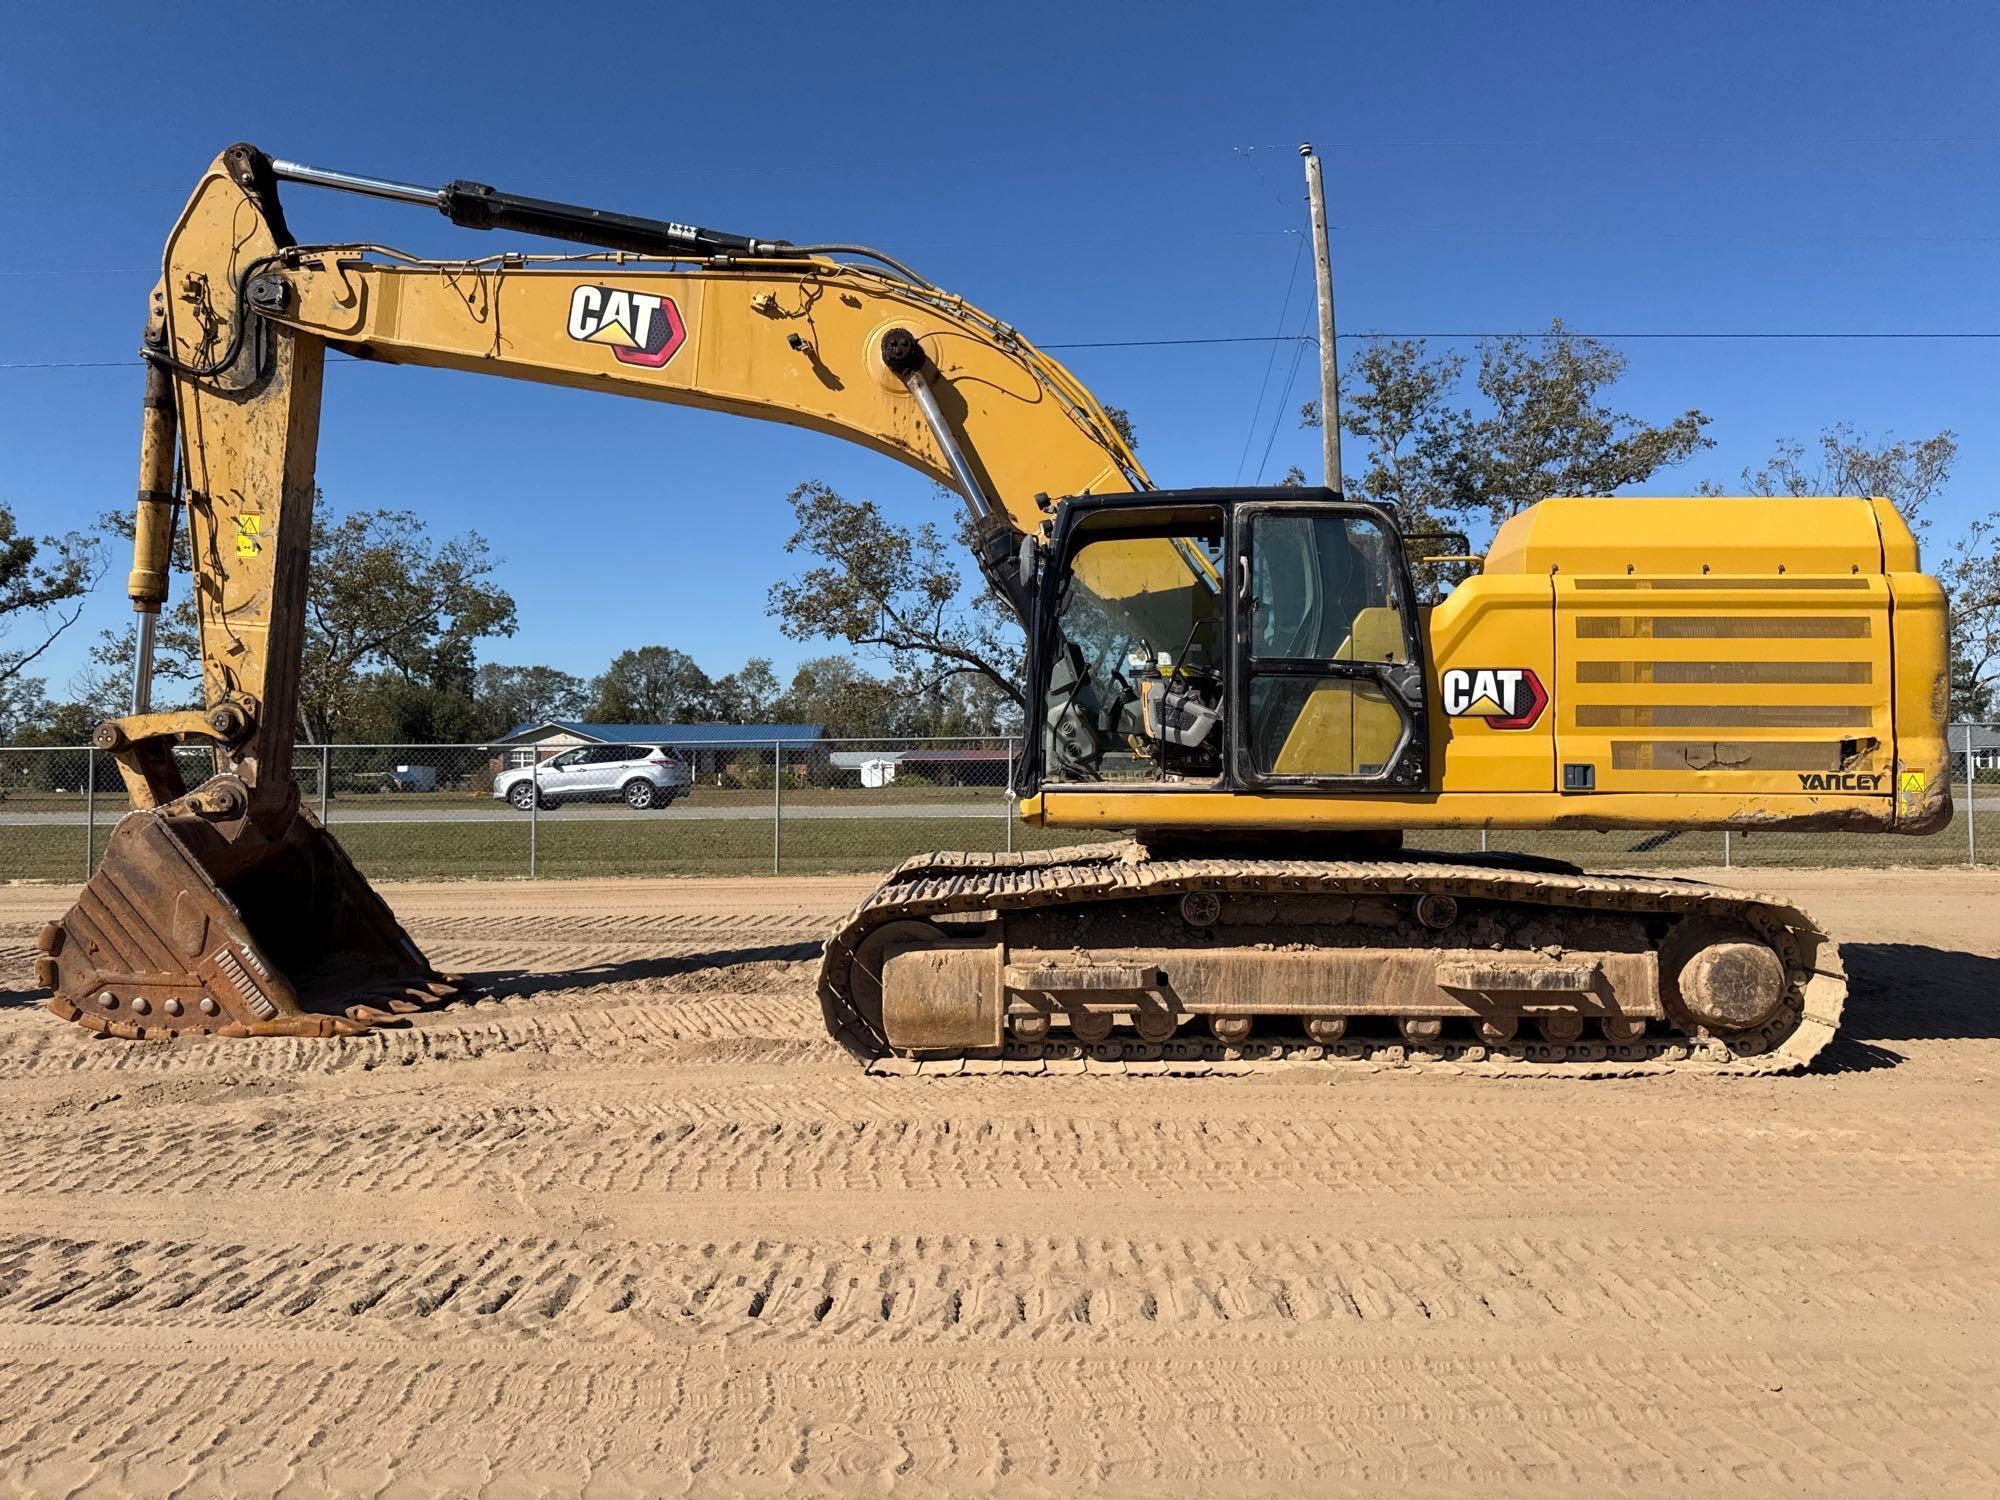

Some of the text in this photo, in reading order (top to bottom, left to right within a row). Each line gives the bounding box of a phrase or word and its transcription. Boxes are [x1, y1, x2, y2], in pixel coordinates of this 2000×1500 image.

[568, 285, 661, 349] CAT
[1443, 669, 1522, 715] CAT
[1798, 773, 1882, 791] YANCEY
